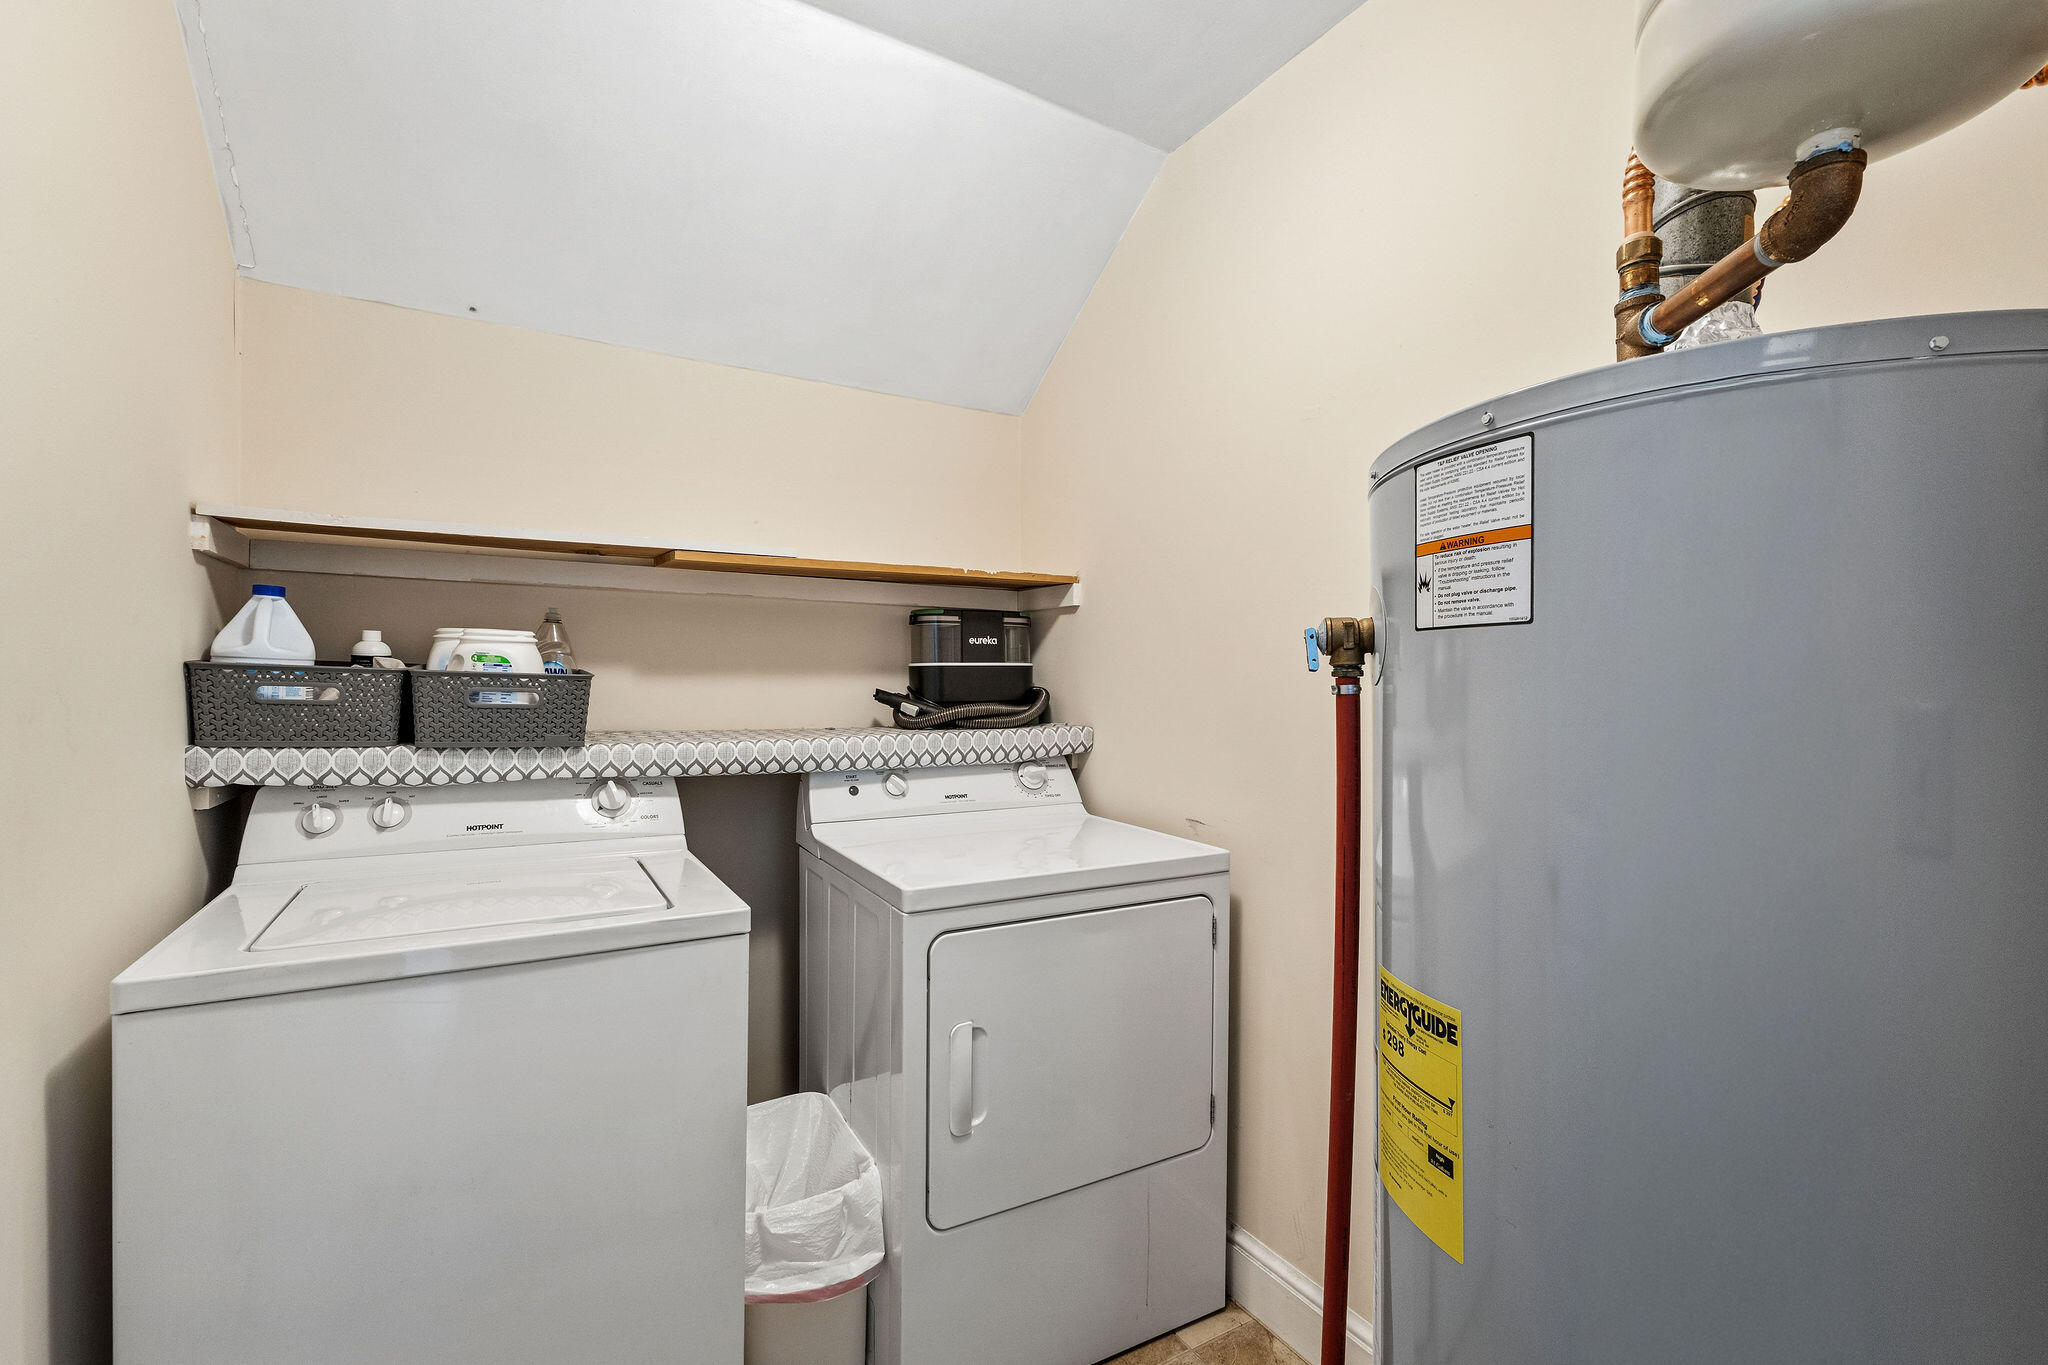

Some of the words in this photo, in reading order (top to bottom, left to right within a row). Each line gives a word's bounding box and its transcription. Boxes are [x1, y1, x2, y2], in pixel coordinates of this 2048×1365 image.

[1475, 445, 1497, 456] OPENING
[1446, 536, 1485, 549] WARNING
[1467, 545, 1490, 555] explosion
[1490, 542, 1511, 551] resulting
[1446, 563, 1470, 571] temperature
[1480, 559, 1500, 567] pressure
[1471, 572, 1495, 580] instructions
[1479, 586, 1503, 594] discharge
[1504, 584, 1517, 592] pipe.
[1476, 602, 1503, 610] accordance
[968, 635, 998, 645] eureka
[466, 823, 505, 832] HOTPOINT
[1380, 978, 1459, 1047] ENERGYGUIDE
[1411, 1112, 1428, 1131] Rating
